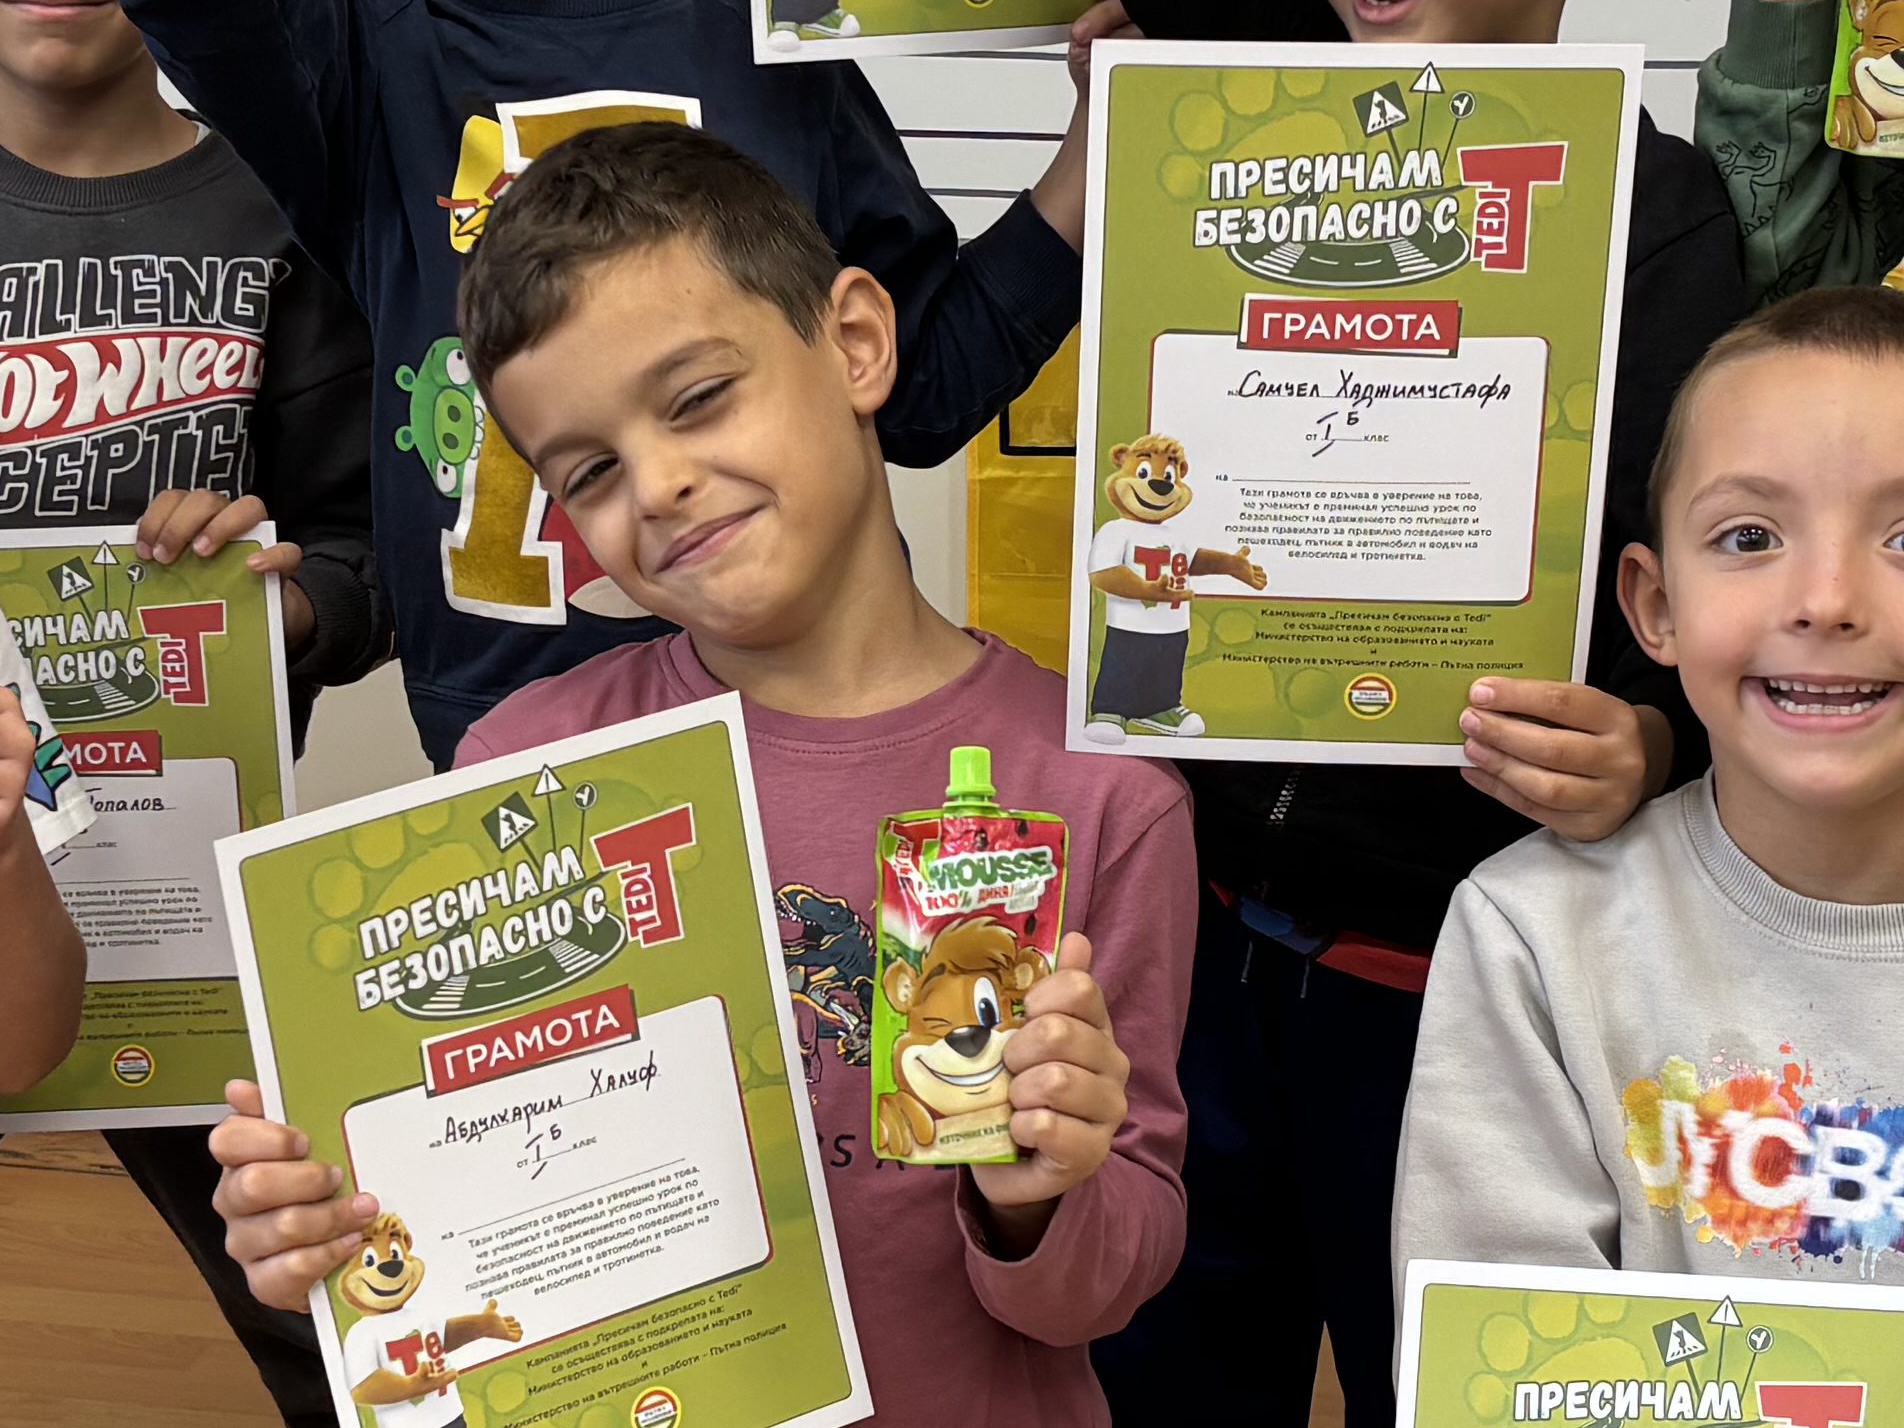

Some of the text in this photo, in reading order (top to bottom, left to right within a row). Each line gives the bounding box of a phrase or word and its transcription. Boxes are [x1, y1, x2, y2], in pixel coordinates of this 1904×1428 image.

[358, 843, 584, 958] ПРЕСИЧАМ
[620, 865, 659, 938] TEDI
[930, 852, 1054, 893] MOUSSE
[354, 885, 609, 1011] БЕЗОПАСНО С
[446, 1003, 622, 1081] ГРАМОТА
